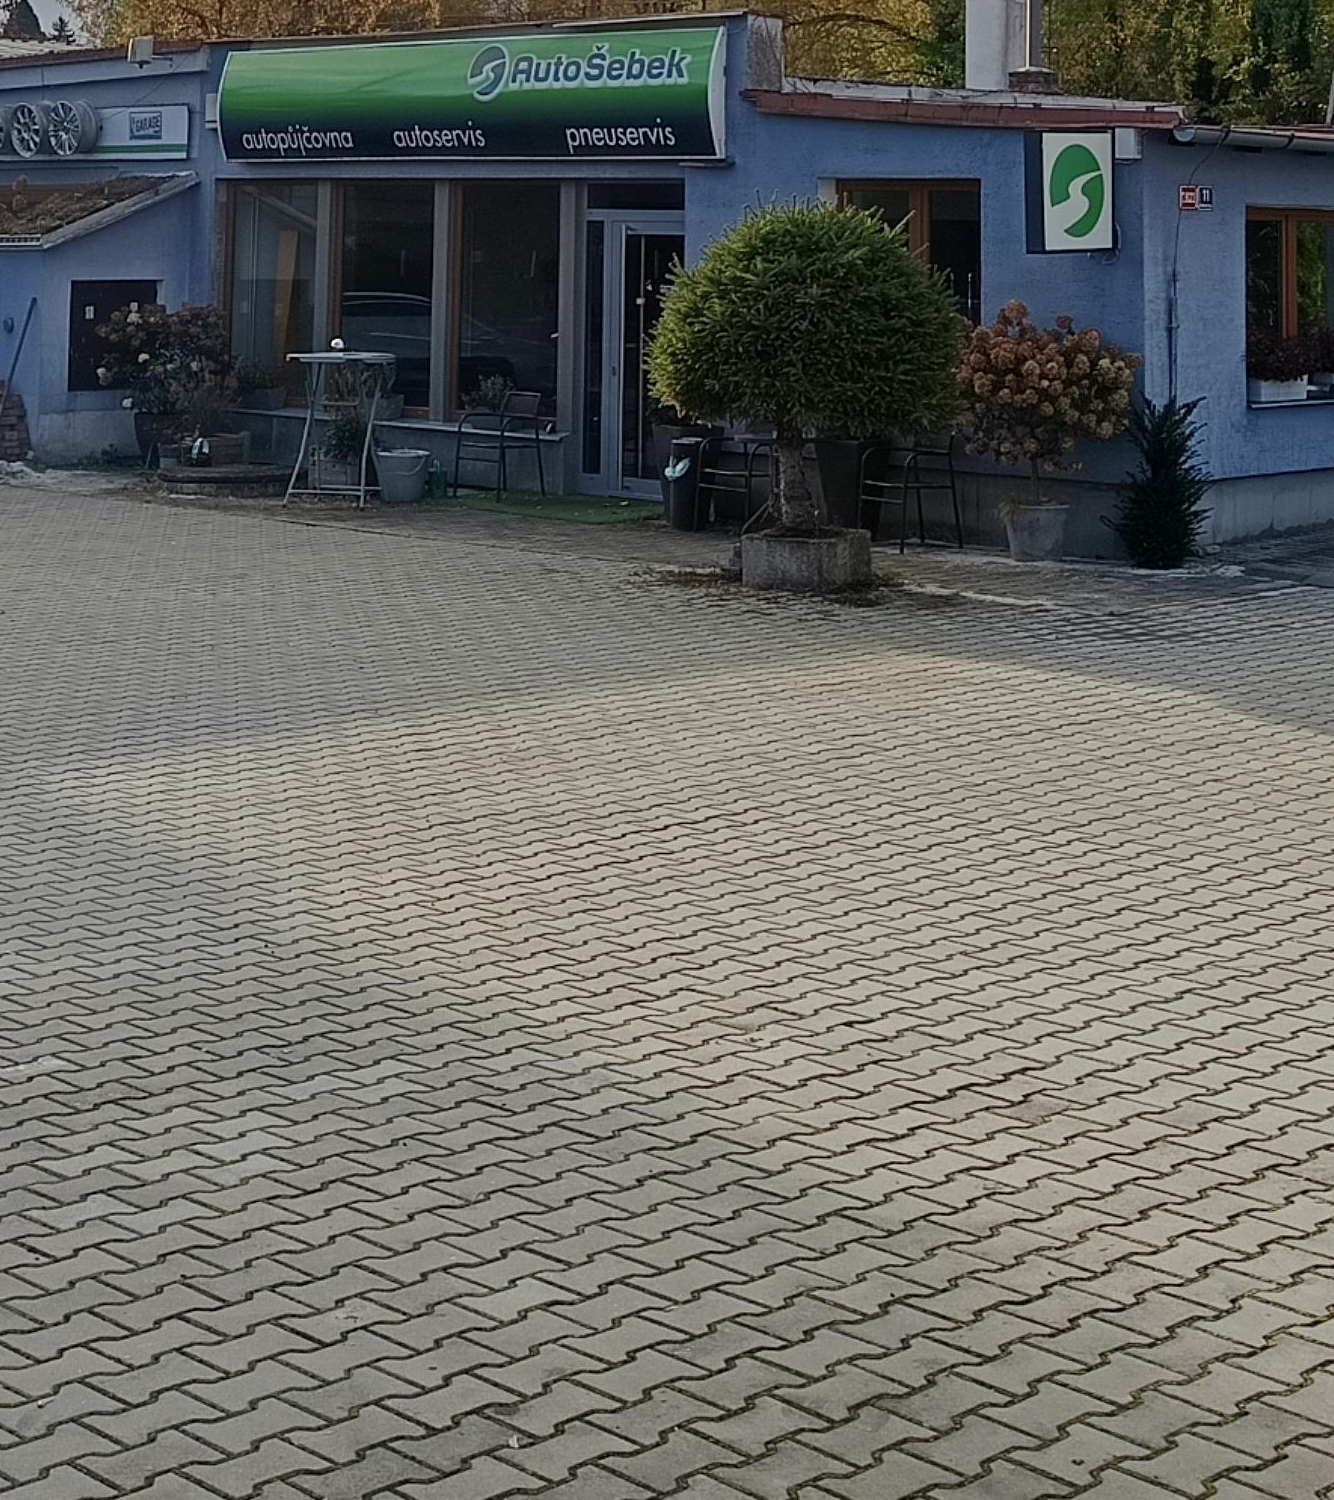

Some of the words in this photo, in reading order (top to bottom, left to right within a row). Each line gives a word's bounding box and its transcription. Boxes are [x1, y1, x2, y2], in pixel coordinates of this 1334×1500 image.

[510, 44, 690, 85] AutoŠebek
[242, 125, 354, 156] autopůjčovna
[393, 120, 485, 148] autoservis
[565, 118, 676, 154] pneuservis
[1202, 188, 1211, 202] 11
